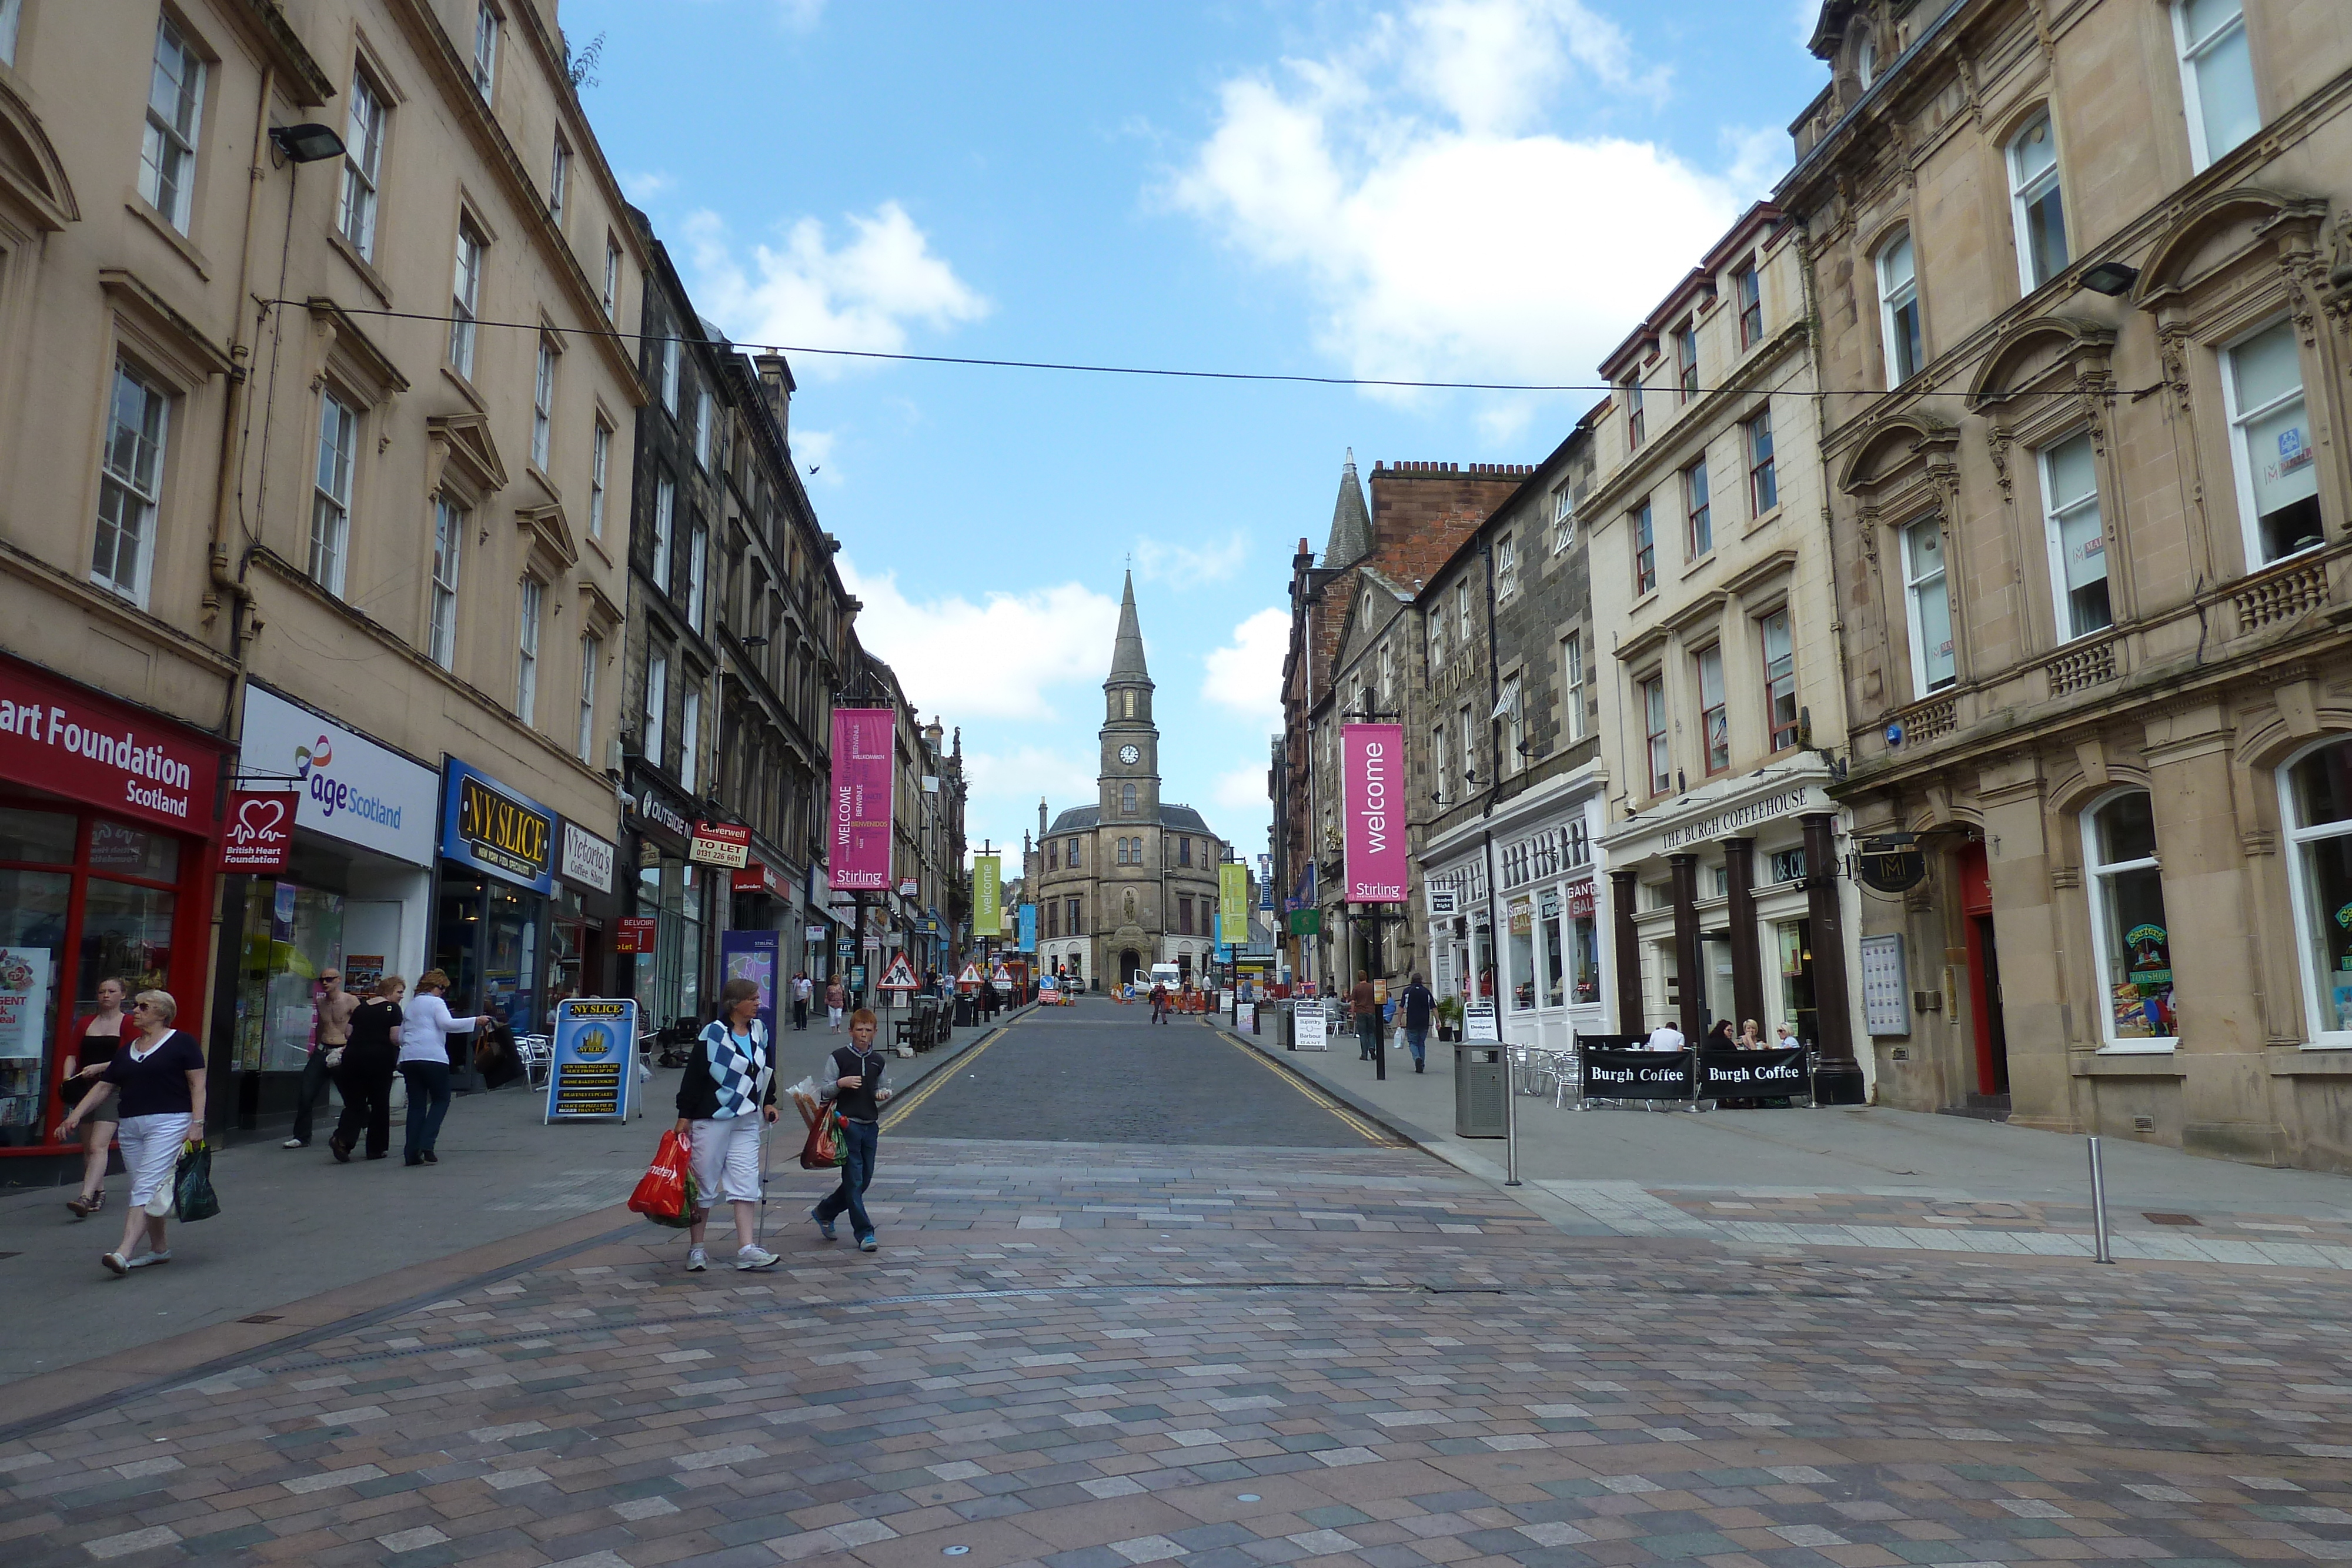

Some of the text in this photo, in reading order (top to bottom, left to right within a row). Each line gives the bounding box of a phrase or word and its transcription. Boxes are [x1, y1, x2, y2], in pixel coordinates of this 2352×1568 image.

[48, 707, 190, 790] Foundation
[126, 780, 188, 818] Scotland
[311, 773, 401, 830] age Scotland
[1361, 742, 1386, 854] welcome
[467, 787, 544, 862] NY SLICE
[652, 801, 684, 835] OUTSIDE
[838, 786, 851, 845] WELCOME
[1662, 787, 1808, 849] THE BURGH COFFEEHOUSE
[225, 855, 279, 864] Foundation
[567, 827, 610, 875] Victoria's
[696, 849, 711, 858] 0131
[727, 854, 740, 862] 6611
[699, 840, 742, 854] TO LET
[570, 860, 604, 888] Coffee Shop
[837, 870, 882, 885] Stirling
[1777, 856, 1788, 881] &
[981, 864, 992, 915] welcome
[1356, 882, 1401, 898] Stirling
[1568, 882, 1594, 898] GANT
[2131, 971, 2170, 982] TOY SHOP
[1591, 1066, 1683, 1083] Burgh Coffee
[1709, 1065, 1799, 1082] Burgh Coffee
